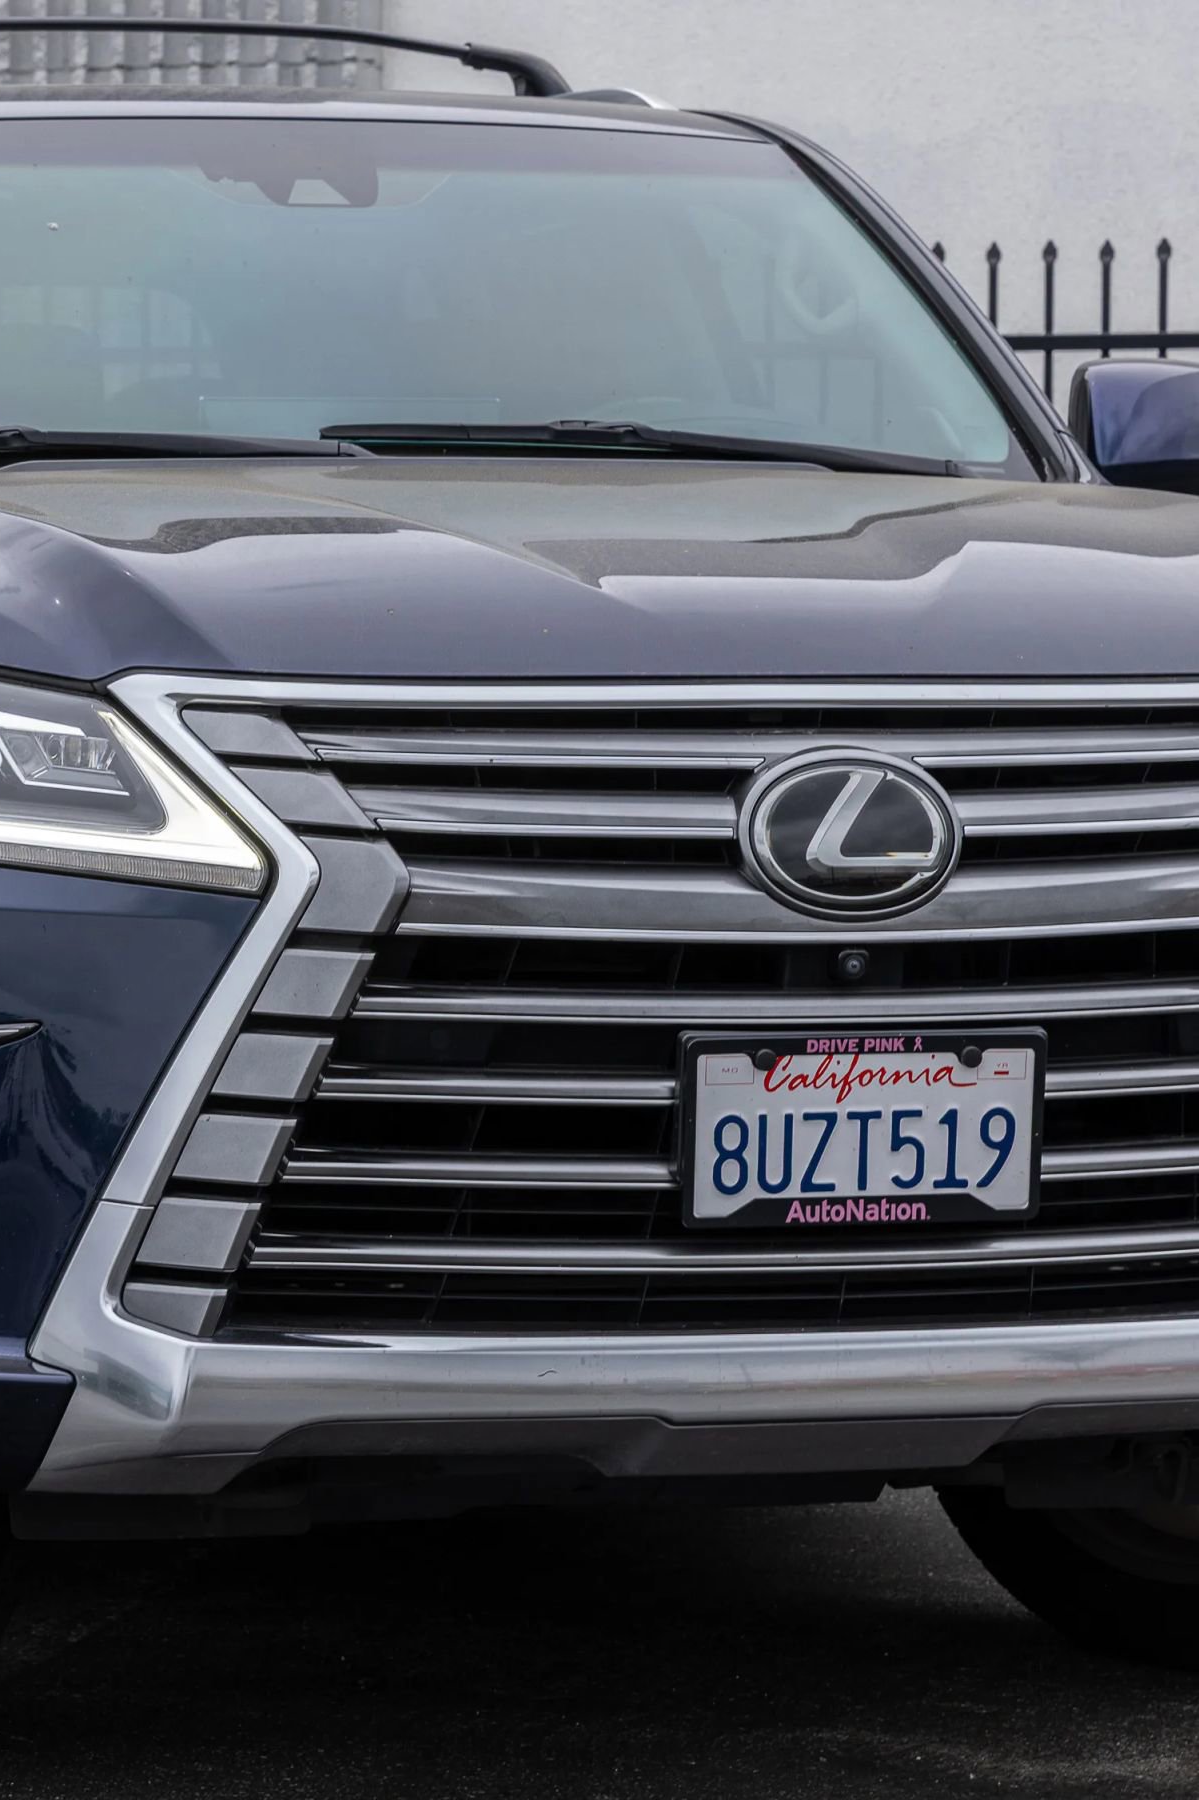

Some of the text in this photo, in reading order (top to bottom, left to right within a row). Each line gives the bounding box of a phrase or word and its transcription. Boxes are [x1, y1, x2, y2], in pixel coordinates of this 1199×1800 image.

[806, 1037, 905, 1053] DRIVE PINK
[764, 1053, 977, 1104] California
[712, 1106, 1016, 1196] 8UZT519
